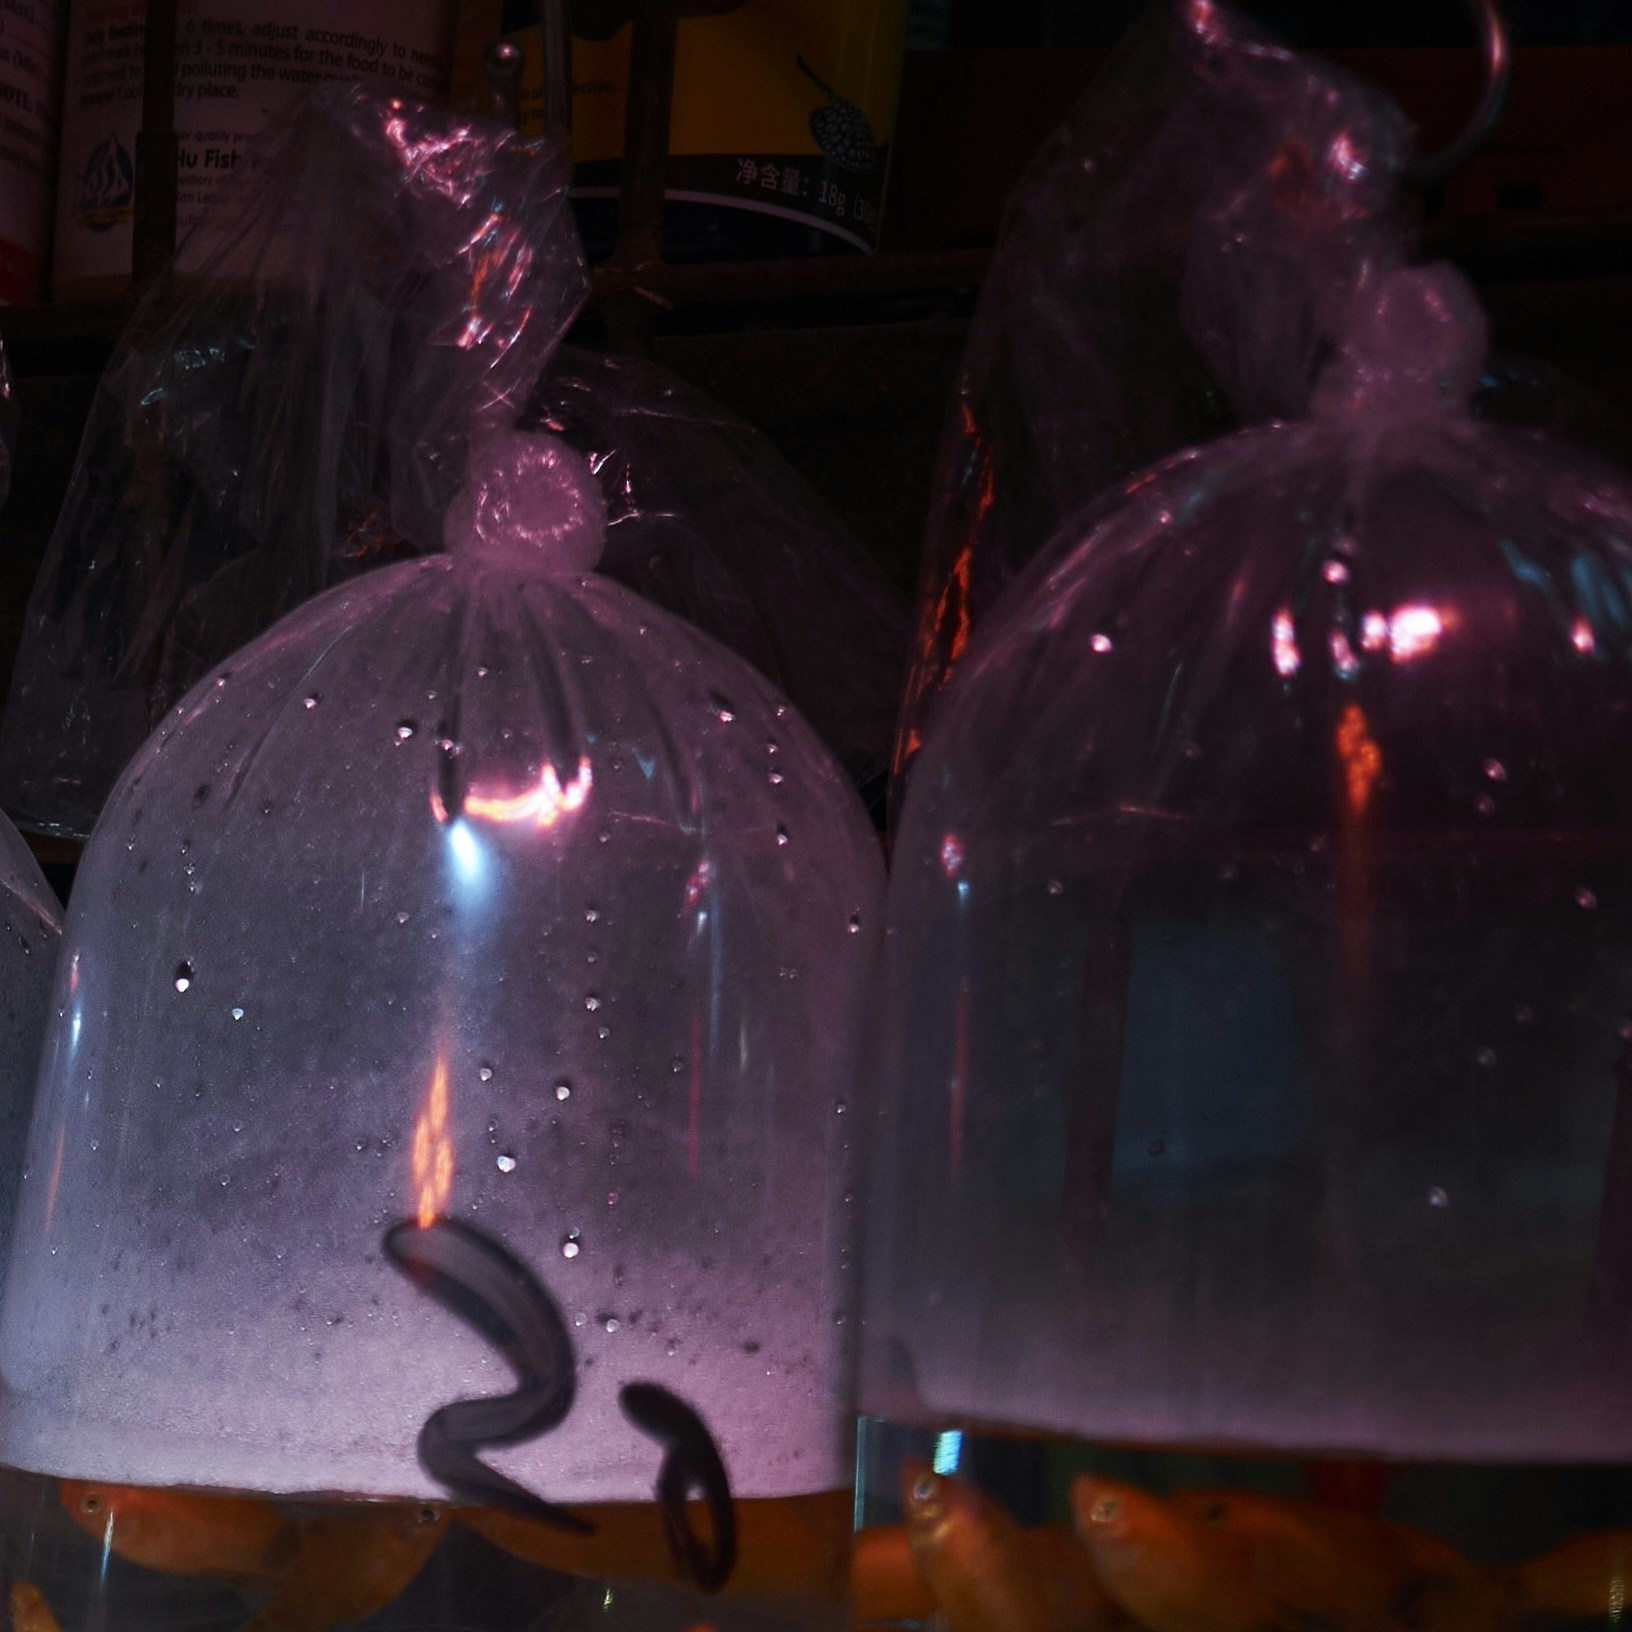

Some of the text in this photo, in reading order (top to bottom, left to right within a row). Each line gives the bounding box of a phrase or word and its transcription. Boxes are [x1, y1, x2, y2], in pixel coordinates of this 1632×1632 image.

[251, 21, 299, 41] adjust
[305, 28, 387, 57] accordingly
[393, 41, 406, 58] to
[181, 60, 247, 82] polluting
[250, 63, 276, 81] the
[279, 67, 322, 84] water
[216, 38, 225, 56] 5
[228, 40, 291, 60] minutes
[294, 44, 315, 63] for
[319, 49, 343, 67] the
[347, 51, 379, 73] food
[382, 61, 396, 78] to
[399, 63, 414, 82] be
[197, 79, 240, 102] place.
[817, 179, 847, 218] 18g
